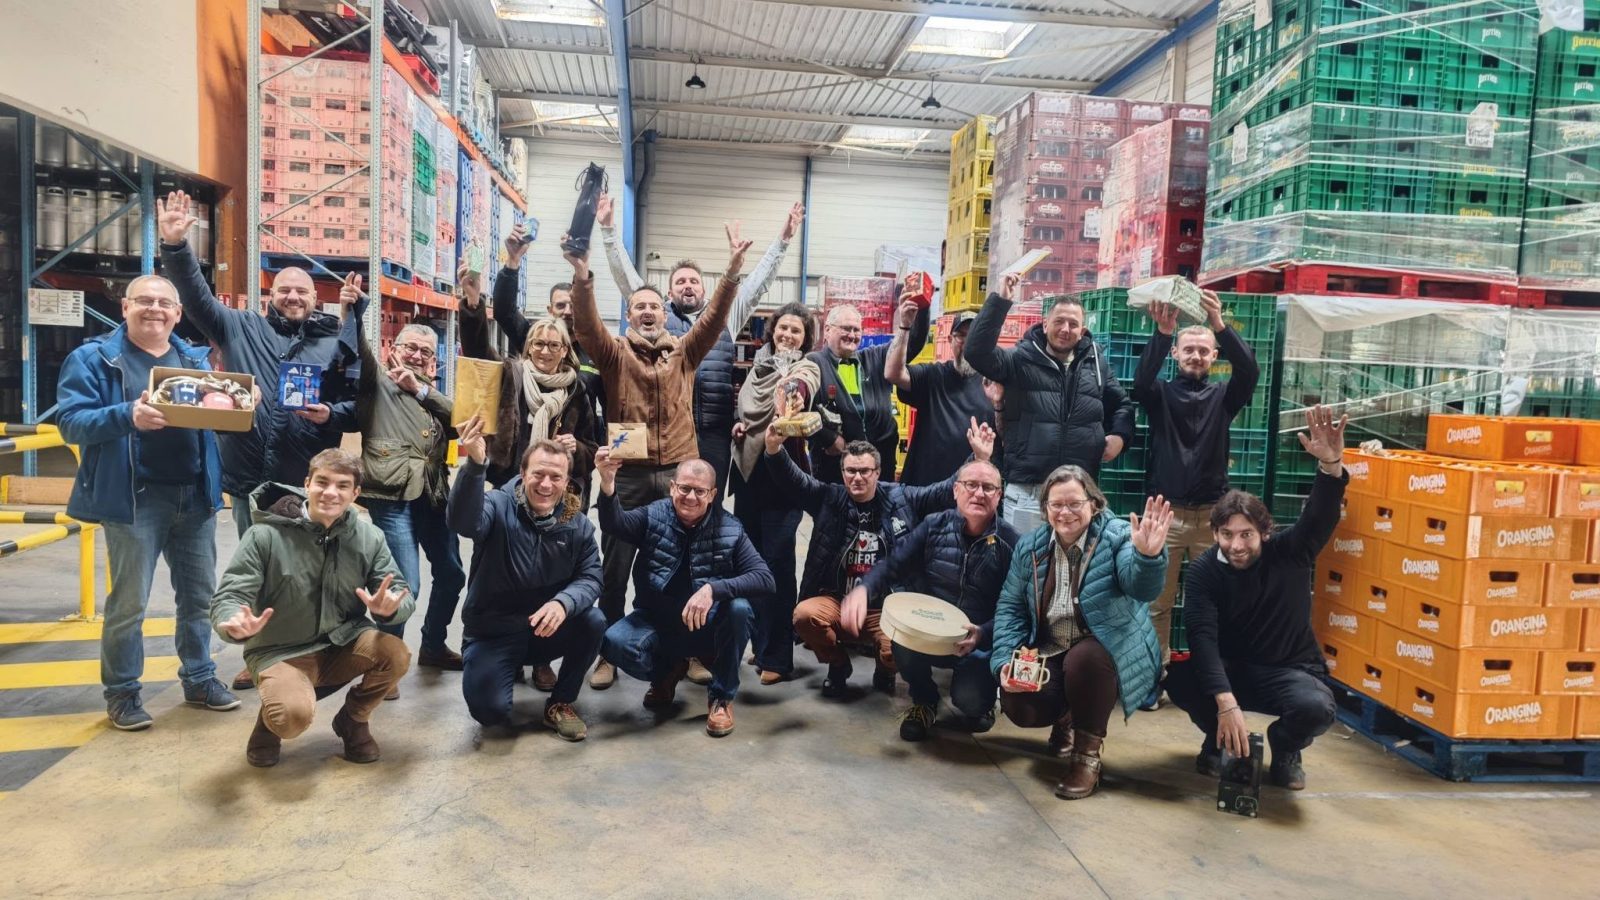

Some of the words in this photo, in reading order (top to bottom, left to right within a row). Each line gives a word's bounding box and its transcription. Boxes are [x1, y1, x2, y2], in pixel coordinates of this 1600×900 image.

[1447, 425, 1482, 444] ORANGINA
[1408, 473, 1446, 491] ORANGINA
[1497, 525, 1554, 547] ORANGINA
[1334, 538, 1364, 552] ORANGINA
[1402, 558, 1439, 575] ORANGINA
[1487, 586, 1518, 598] ORANGINA
[1329, 612, 1358, 629] ORANGINA
[1491, 614, 1547, 636] ORANGINA
[1396, 640, 1434, 660] ORANGINA
[1481, 674, 1511, 686] ORANGINA
[1563, 676, 1594, 688] ORANGINA
[1485, 702, 1542, 724] ORANGINA
